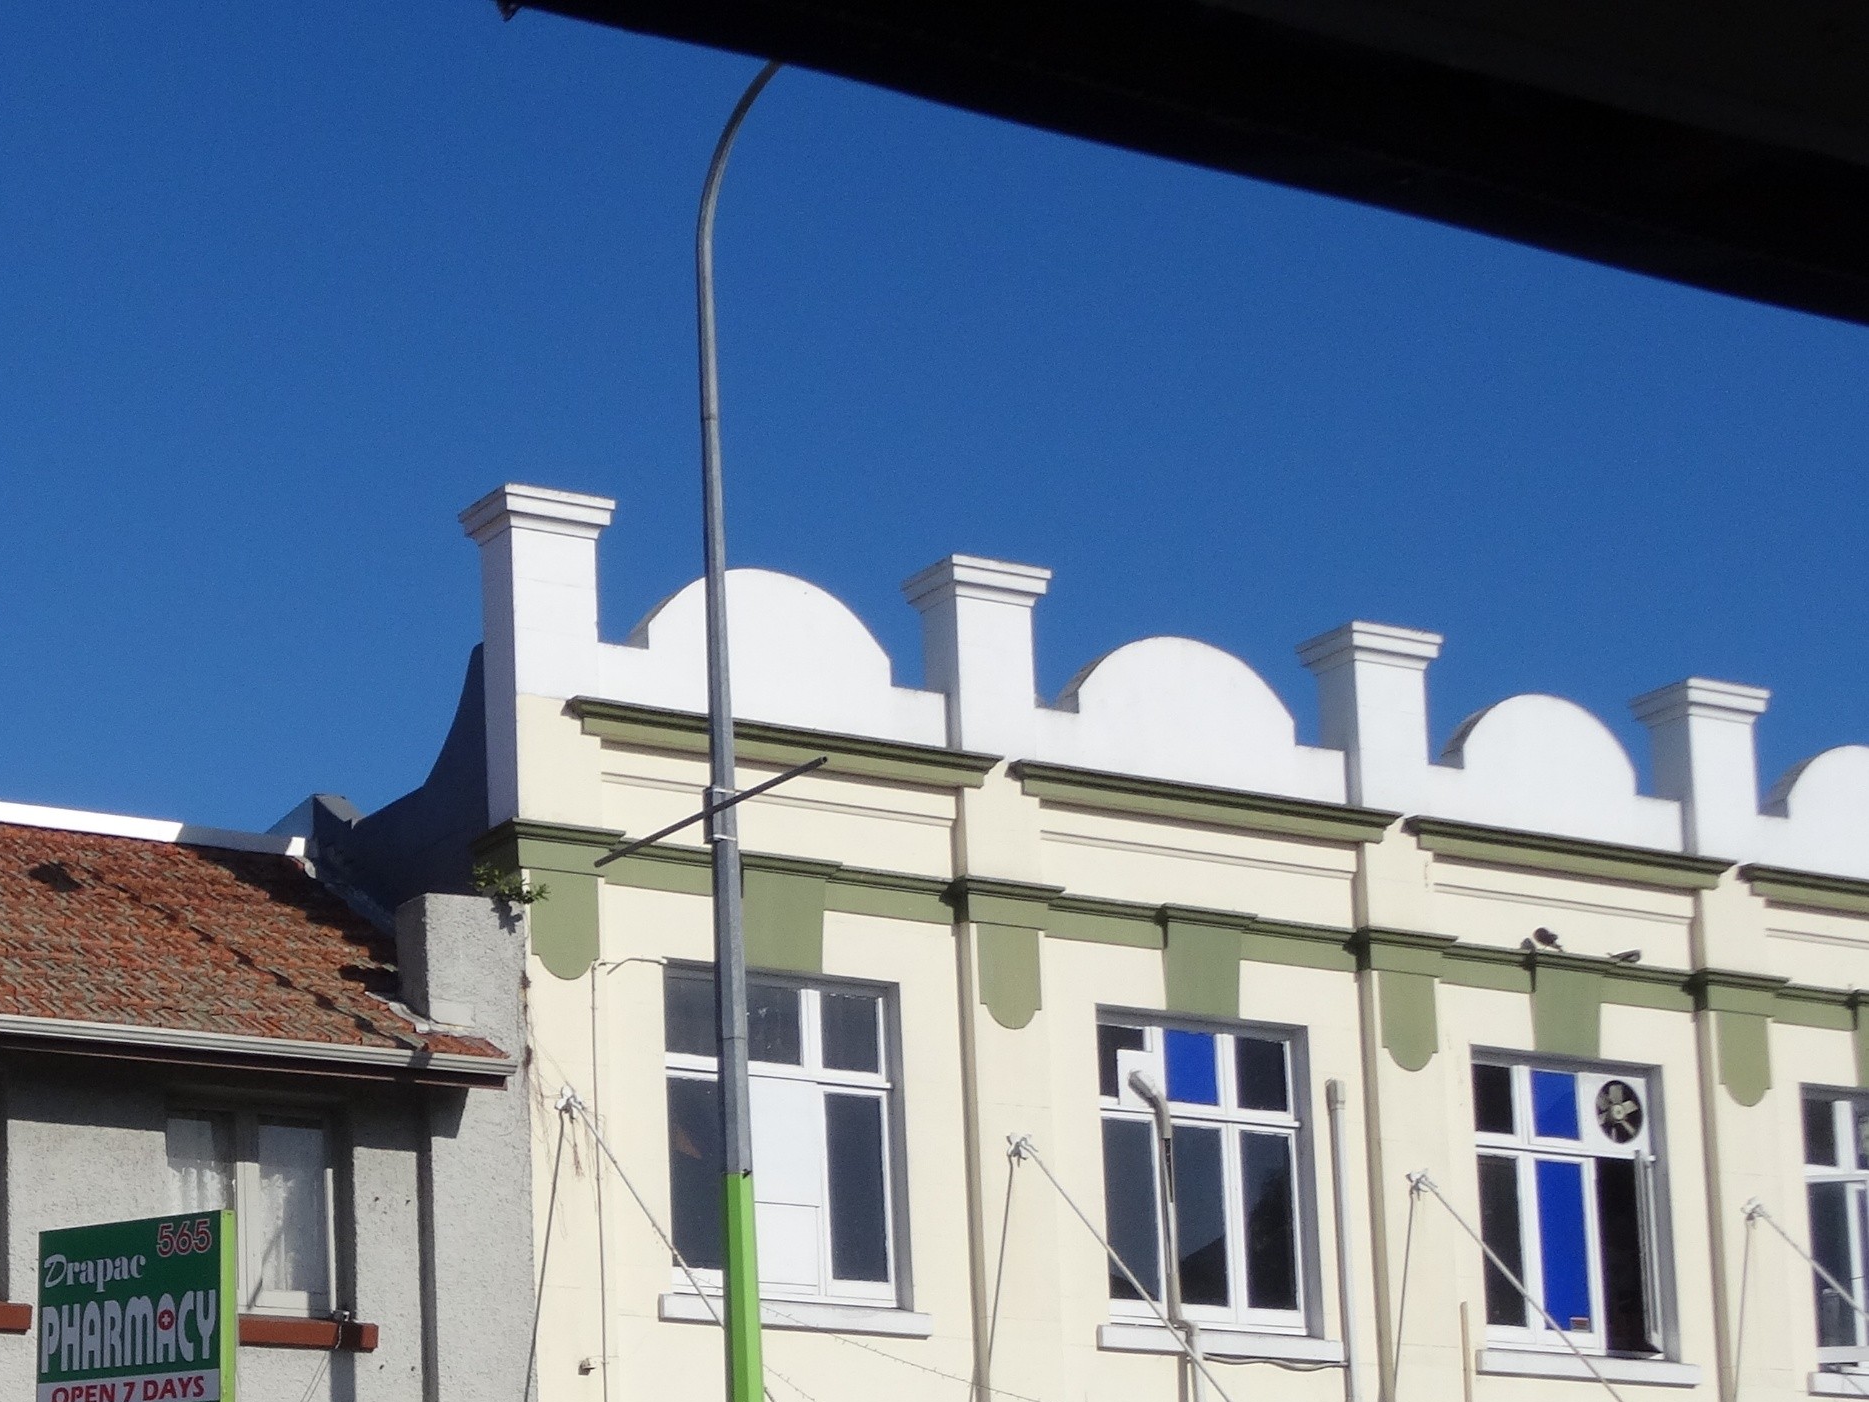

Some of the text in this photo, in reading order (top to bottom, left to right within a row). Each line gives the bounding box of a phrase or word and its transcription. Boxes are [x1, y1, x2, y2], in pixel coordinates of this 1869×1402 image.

[156, 1218, 212, 1258] 565
[43, 1254, 146, 1293] Drapac
[41, 1289, 217, 1374] PHARMACY
[123, 1382, 136, 1402] 7
[142, 1375, 205, 1401] DAYS
